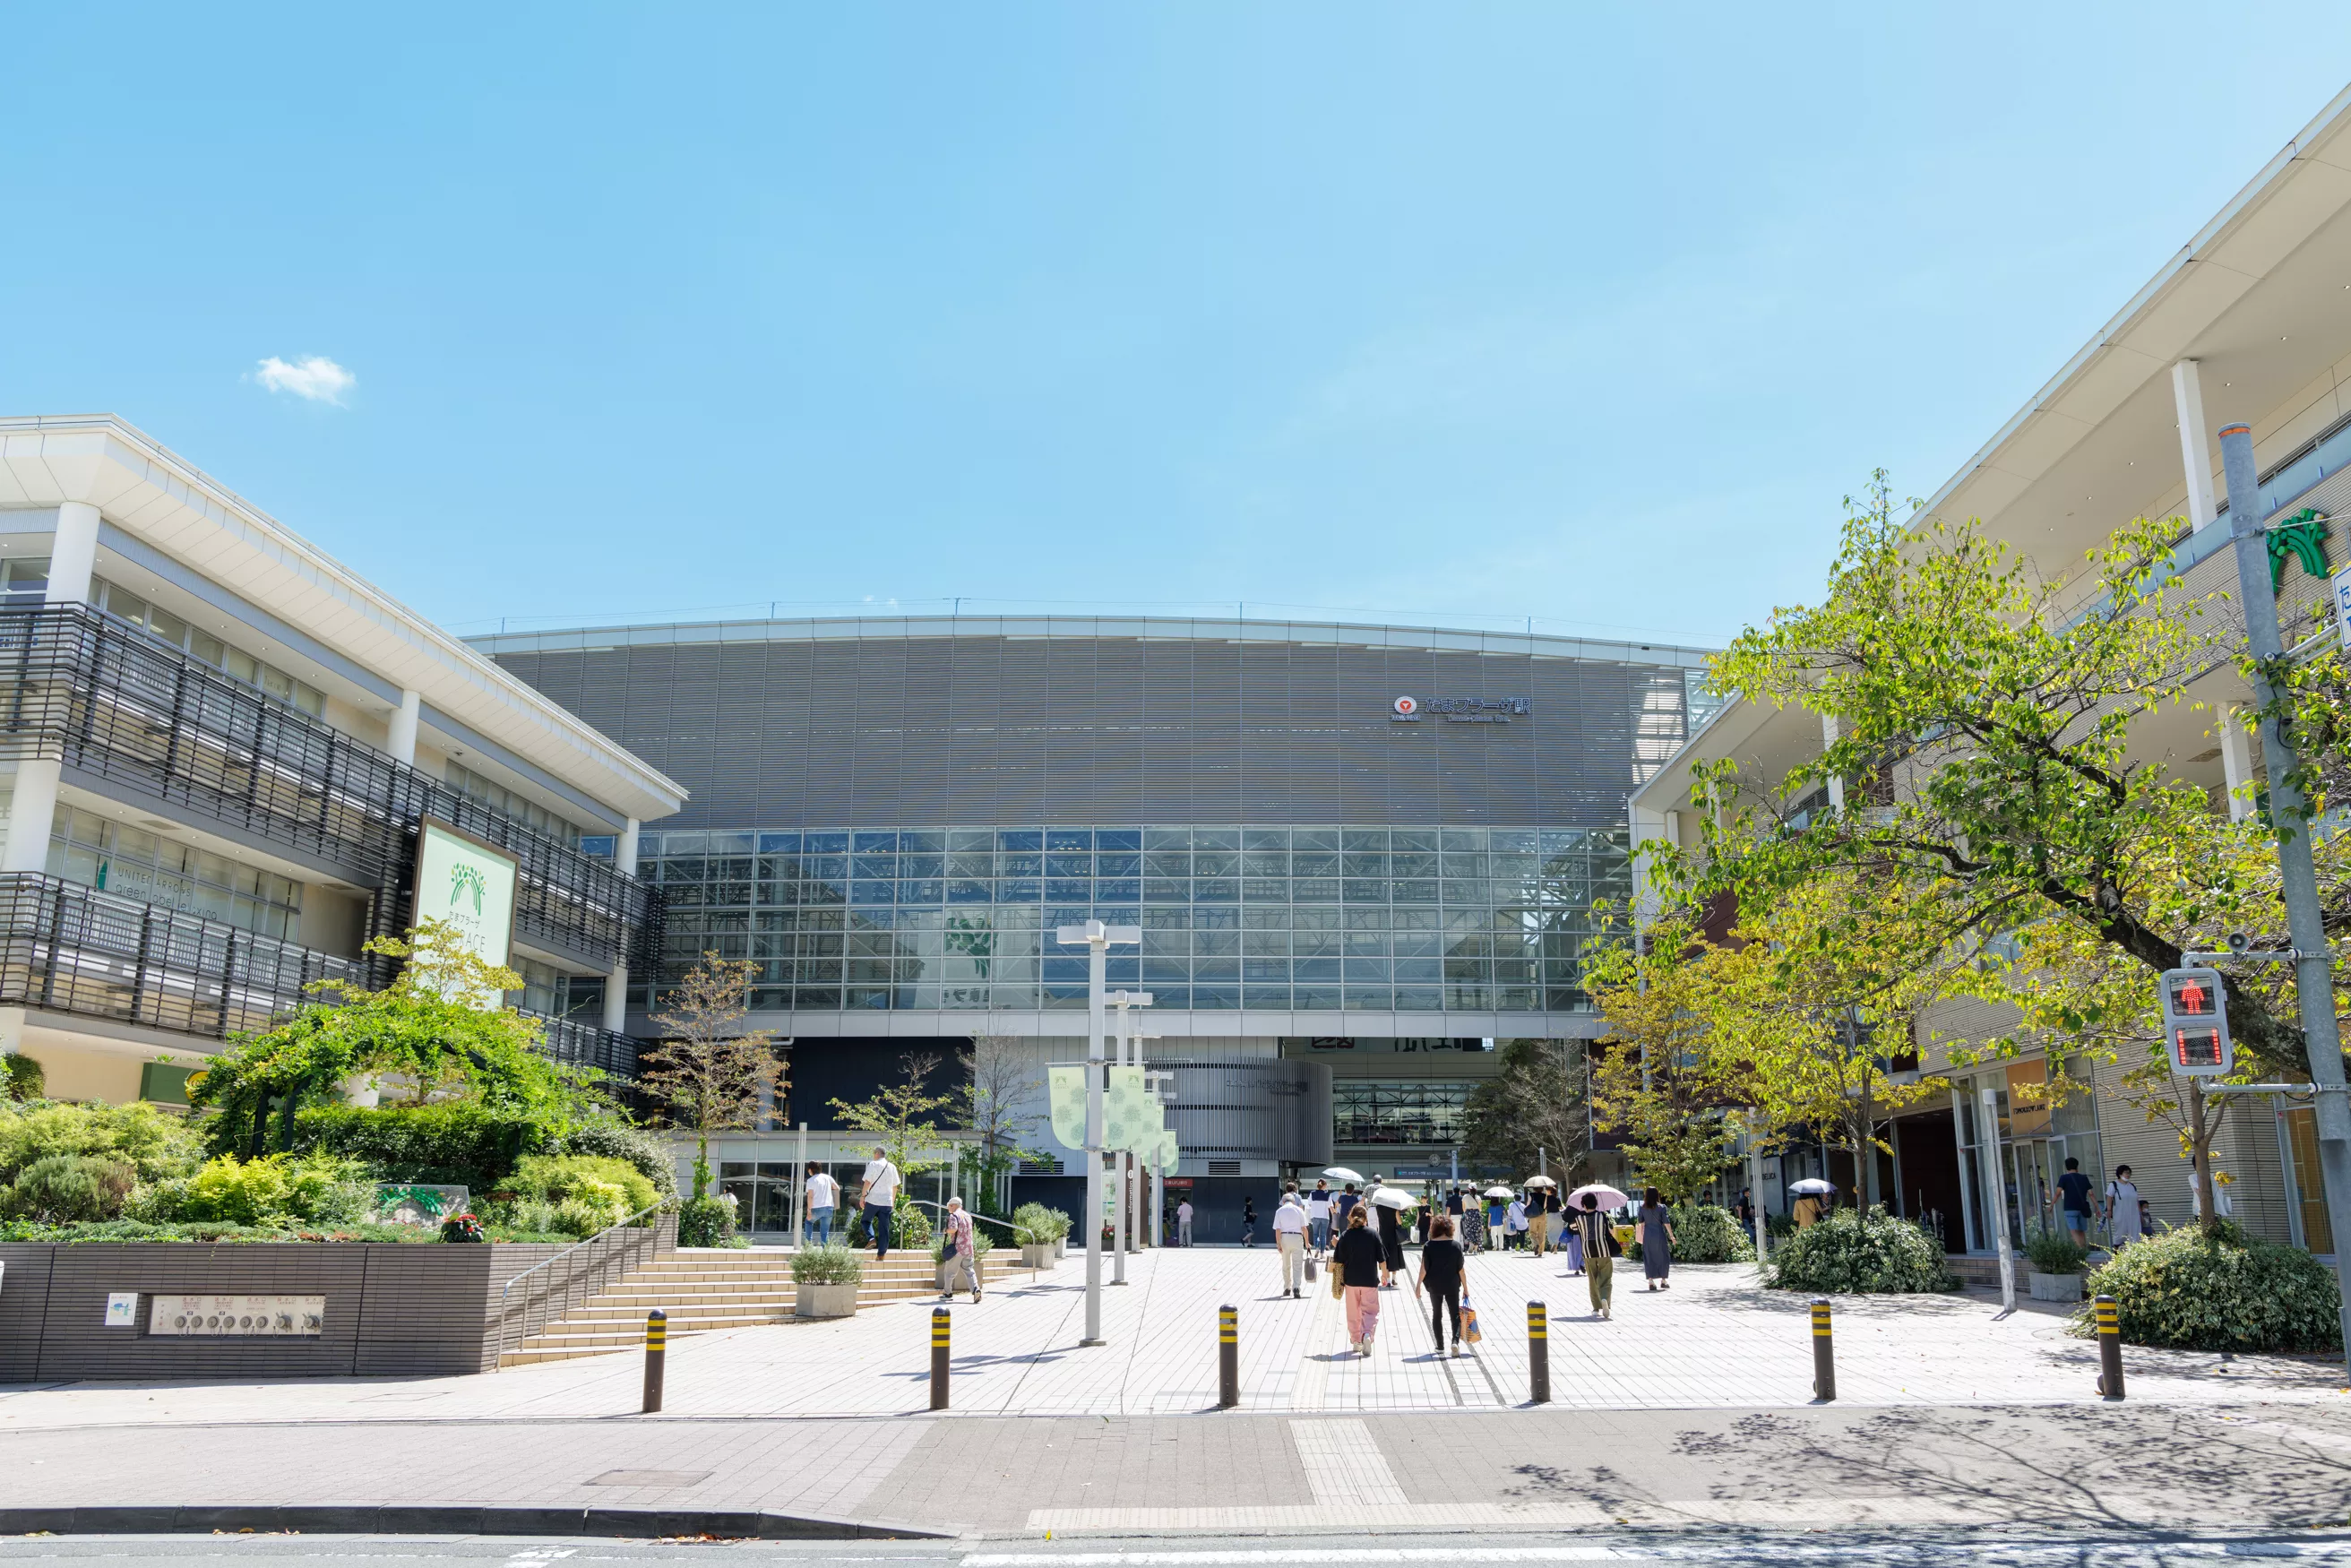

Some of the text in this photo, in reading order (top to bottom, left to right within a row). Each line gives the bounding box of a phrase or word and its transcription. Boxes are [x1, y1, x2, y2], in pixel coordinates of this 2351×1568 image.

[1425, 697, 1531, 714] たまプラーザ駅
[118, 867, 151, 885] UNITED
[116, 883, 146, 901] green
[449, 910, 481, 929] たまプラーザ
